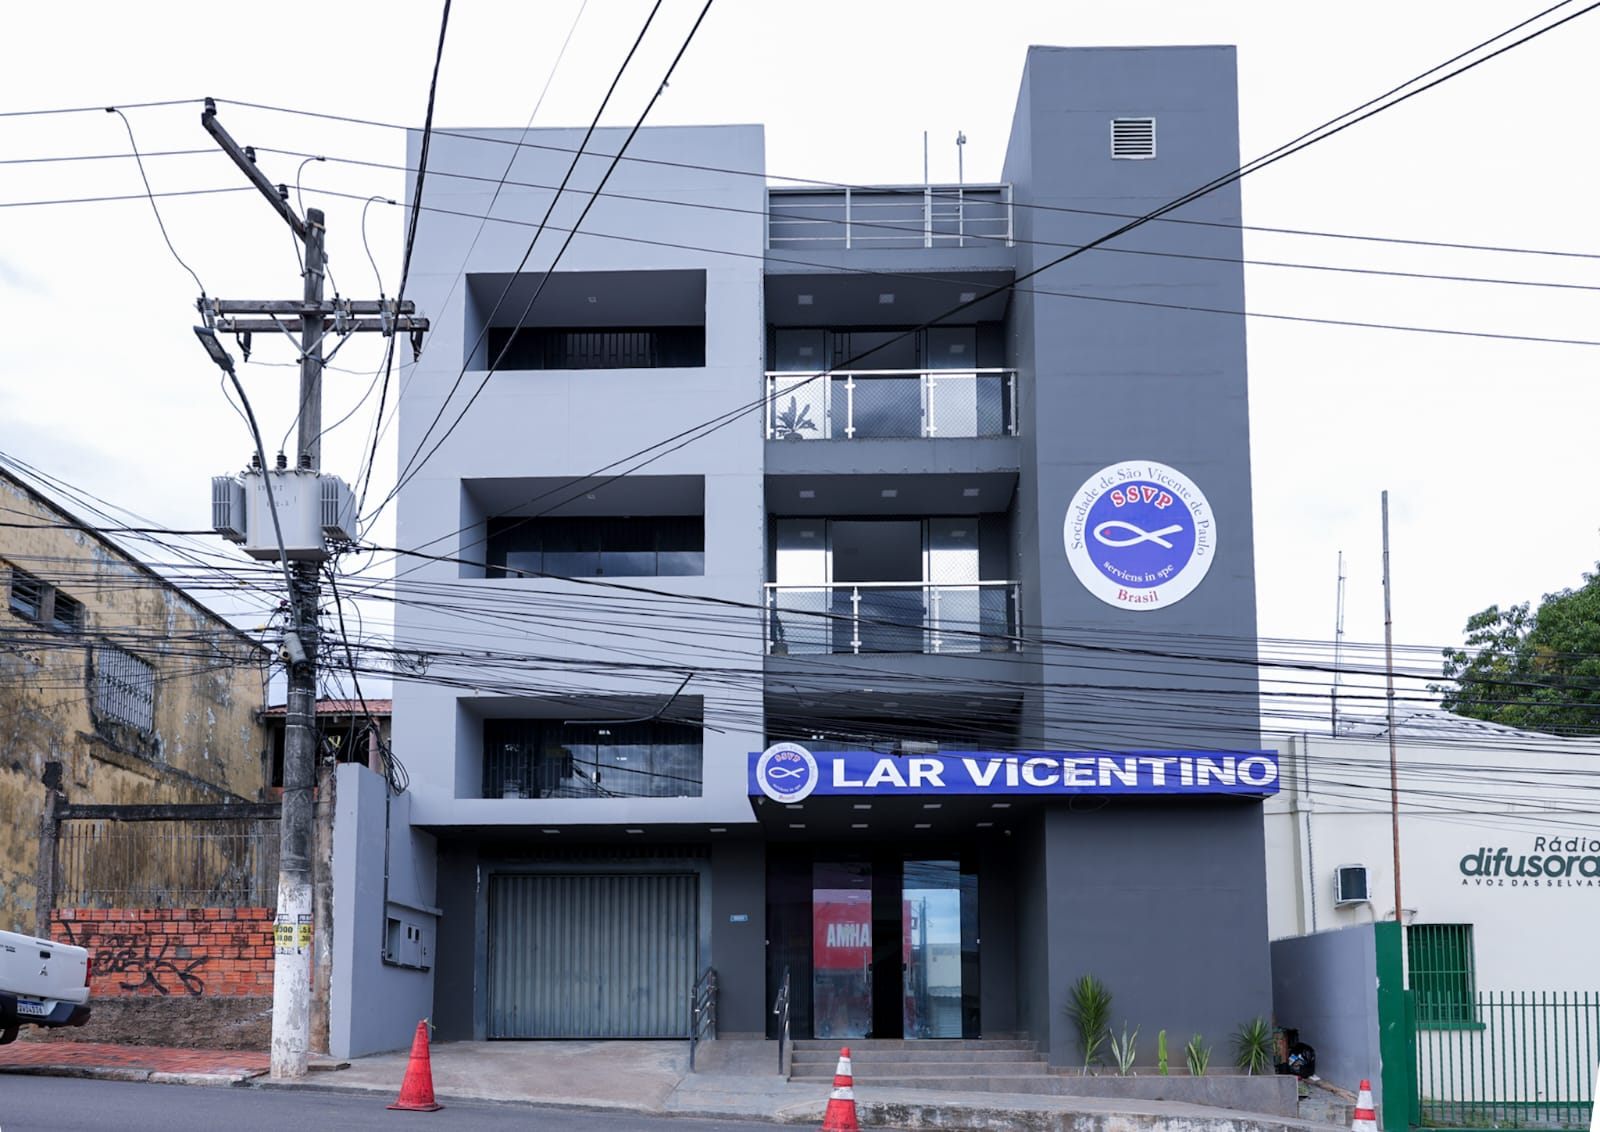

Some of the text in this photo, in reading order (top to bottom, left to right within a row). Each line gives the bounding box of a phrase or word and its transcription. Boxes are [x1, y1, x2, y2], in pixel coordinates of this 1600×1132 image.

[1111, 486, 1173, 508] SSVP
[1071, 467, 1210, 556] Sociedade de São Vicente de Paulo
[1103, 560, 1143, 583] serviens
[1145, 573, 1156, 582] in
[1117, 589, 1159, 603] Brasil
[832, 758, 946, 788] LAR
[961, 756, 1279, 787] VICENTINO
[1534, 836, 1600, 852] Rádio
[1460, 847, 1600, 878] difusora
[1475, 879, 1504, 887] VOZ
